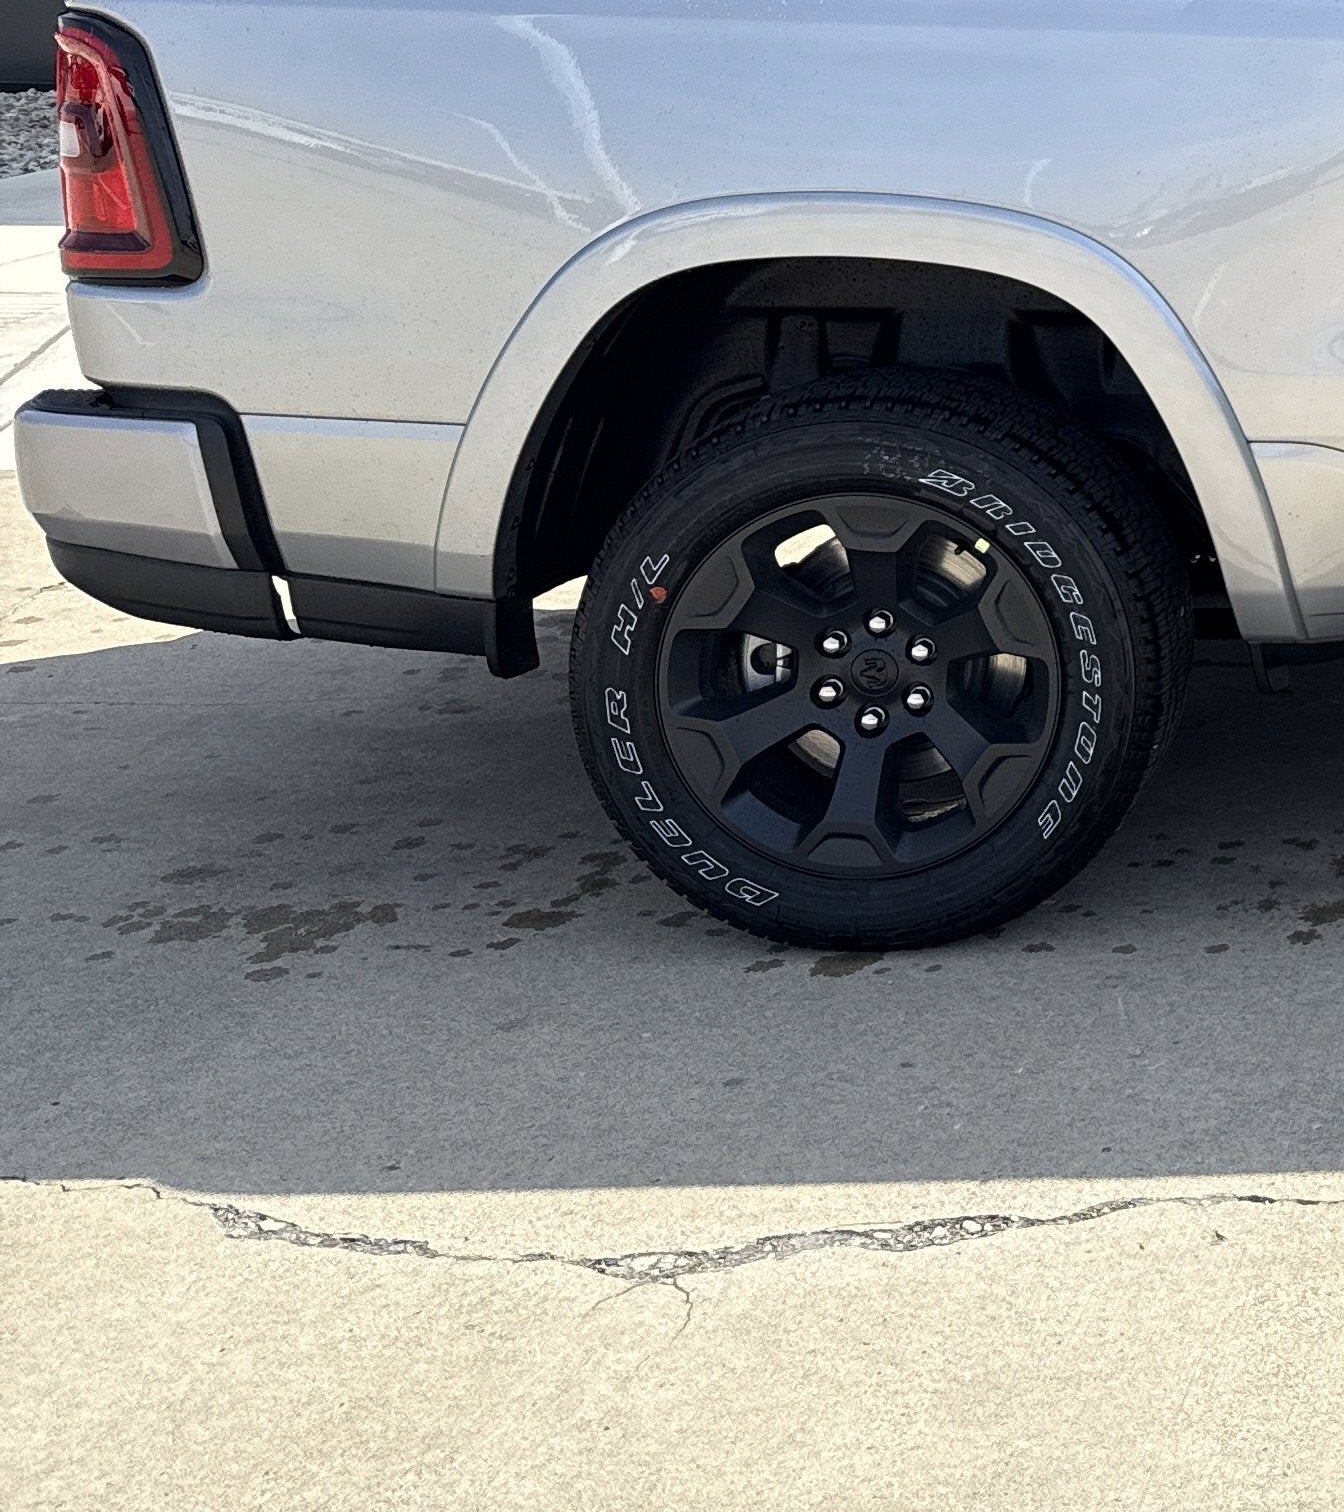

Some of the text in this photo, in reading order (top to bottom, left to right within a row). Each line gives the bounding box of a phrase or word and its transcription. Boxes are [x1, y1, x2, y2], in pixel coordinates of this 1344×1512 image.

[605, 554, 779, 906] DUELER H/L
[918, 469, 1102, 839] BRIDGESTONE
